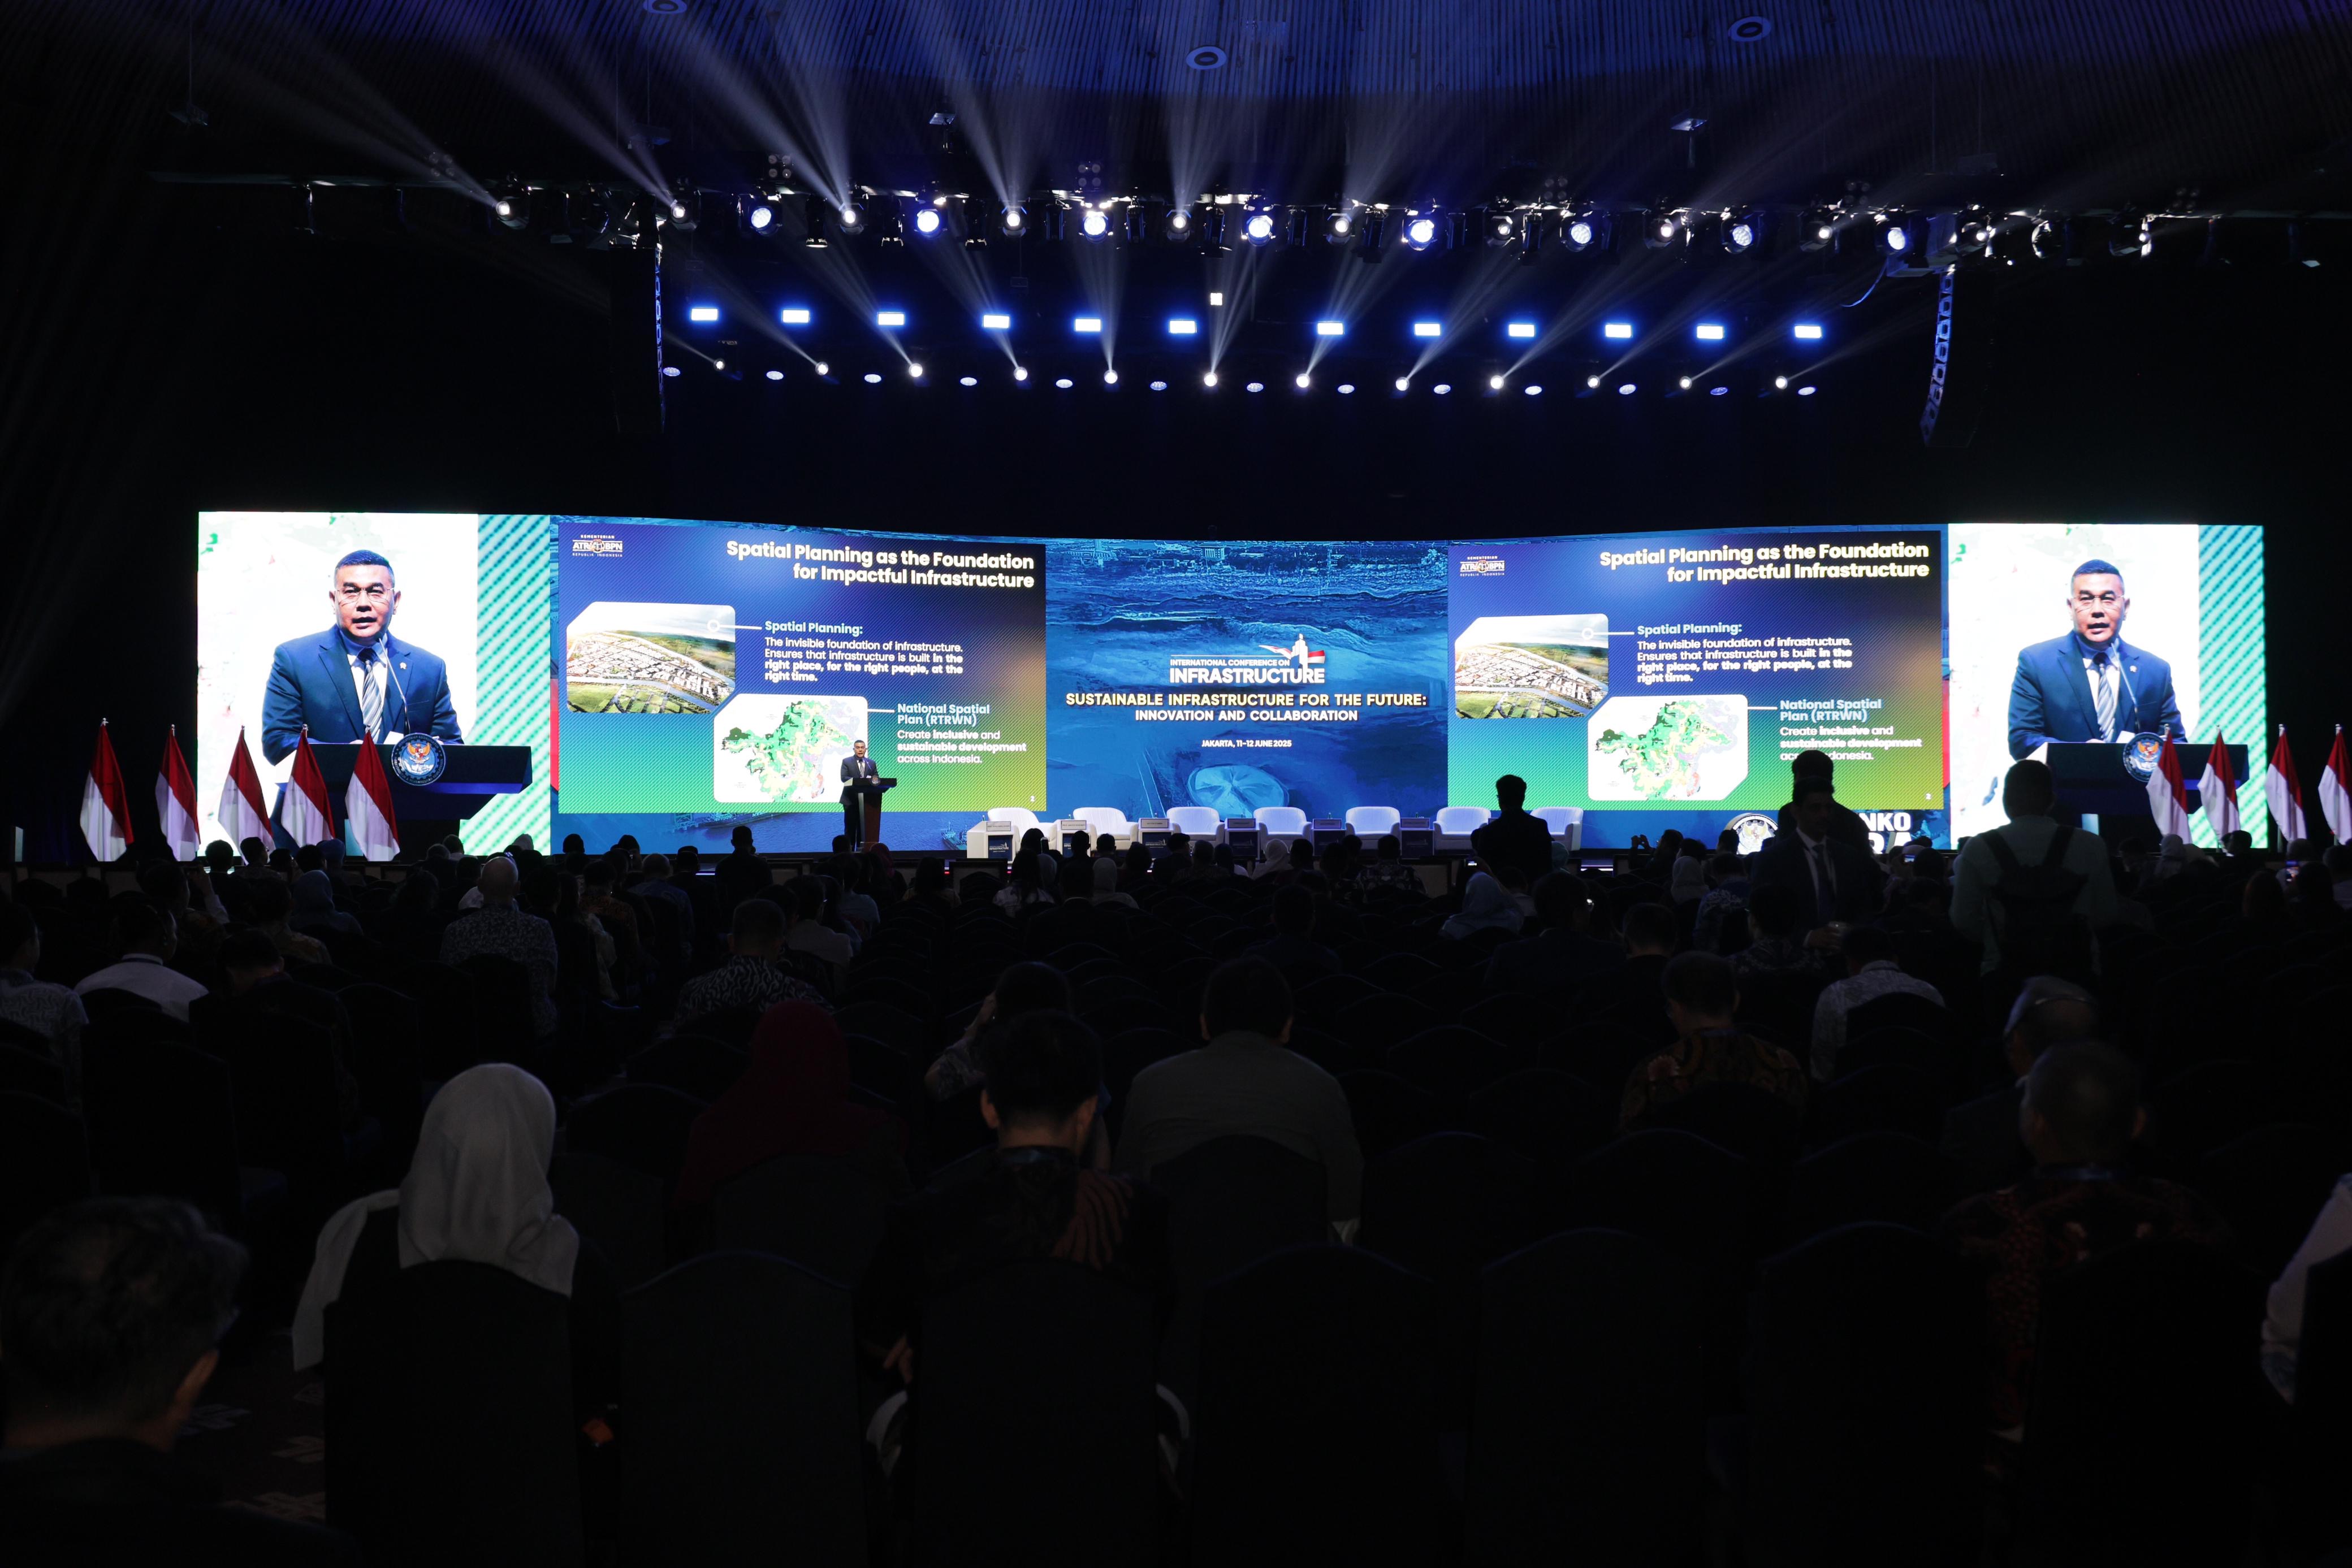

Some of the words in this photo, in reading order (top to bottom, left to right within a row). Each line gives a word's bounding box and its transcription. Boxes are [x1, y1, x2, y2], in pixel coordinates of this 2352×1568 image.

[727, 540, 791, 561] Spatial
[794, 544, 873, 565] Planning
[876, 552, 897, 564] as
[901, 550, 930, 566] the
[933, 552, 1034, 569] Foundation
[1599, 549, 1666, 569] Spatial
[1669, 545, 1753, 565] Planning
[1757, 548, 1780, 561] as
[1784, 544, 1815, 561] the
[1819, 542, 1929, 559] Foundation
[793, 562, 819, 579] for
[821, 565, 907, 584] Impactful
[911, 569, 1035, 588] Infrastructure
[1667, 566, 1694, 582] for
[1697, 563, 1791, 585] Impactful
[1795, 562, 1929, 578] Infrastructure
[765, 620, 806, 634] Spatial
[808, 622, 863, 637] Planning:
[1637, 623, 1681, 637] Spatial
[1683, 622, 1743, 635] Planning:
[764, 636, 784, 647] The
[785, 637, 825, 648] invisible
[826, 639, 880, 650] foundation
[882, 640, 893, 651] of
[894, 641, 963, 652] infrastructure.
[1637, 640, 1657, 650] The
[1658, 639, 1701, 649] invisible
[1702, 638, 1762, 648] foundation
[1763, 637, 1775, 647] of
[1776, 636, 1852, 647] infrastructure.
[764, 648, 803, 660] Ensures
[805, 649, 827, 660] that
[829, 650, 896, 662] infrastructure
[898, 652, 906, 662] is
[909, 652, 931, 662] built
[932, 652, 943, 663] in
[945, 653, 963, 664] the
[1637, 652, 1677, 661] Ensures
[1680, 651, 1703, 660] that
[1705, 649, 1778, 660] infrastructure
[1780, 648, 1790, 658] is
[1792, 648, 1817, 658] built
[1818, 647, 1831, 657] in
[1832, 647, 1853, 657] the
[764, 660, 790, 673] right
[792, 660, 824, 673] place,
[826, 661, 842, 672] for
[844, 661, 862, 672] the
[863, 662, 889, 674] right
[891, 663, 929, 675] people,
[931, 664, 944, 674] at
[945, 664, 963, 674] the
[1278, 658, 1291, 666] ON
[1637, 662, 1664, 673] right
[1666, 661, 1701, 673] place,
[1702, 660, 1719, 670] for
[1720, 660, 1741, 670] the
[1743, 659, 1771, 672] right
[1773, 659, 1815, 672] people,
[1817, 659, 1831, 669] at
[1832, 659, 1853, 669] the
[764, 670, 790, 683] right
[790, 671, 818, 682] time.
[1170, 668, 1325, 684] INFRASTRUCTURE
[1637, 671, 1664, 685] right
[1664, 671, 1694, 682] time.
[1066, 693, 1163, 706] SUSTAINABLE
[1168, 694, 1294, 706] INFRASTRUCTURE
[1299, 694, 1329, 706] FOR
[1334, 694, 1361, 706] THE
[1367, 694, 1426, 706] FUTURE:
[1780, 699, 1835, 712] National
[1836, 698, 1882, 712] Spatial
[897, 703, 947, 716] National
[949, 703, 990, 716] Spatial
[1135, 709, 1214, 721] INNOVATION
[1218, 710, 1246, 721] AND
[1250, 710, 1357, 721] COLLABORATION
[1780, 711, 1809, 721] Plan
[1811, 708, 1867, 724] (RTRWN)
[897, 714, 923, 725] Plan
[926, 713, 977, 727] (RTRWN)
[897, 730, 931, 739] Create
[933, 729, 979, 739] inclusive
[980, 730, 1000, 739] and
[1780, 727, 1818, 735] Create
[1819, 725, 1870, 735] inclusive
[1871, 726, 1893, 735] and
[897, 741, 957, 751] sustainable
[958, 742, 1027, 754] development
[1780, 738, 1847, 748] sustainable
[1847, 738, 1922, 750] development
[932, 754, 983, 763] Indonesia.
[1825, 751, 1874, 760] donesia.
